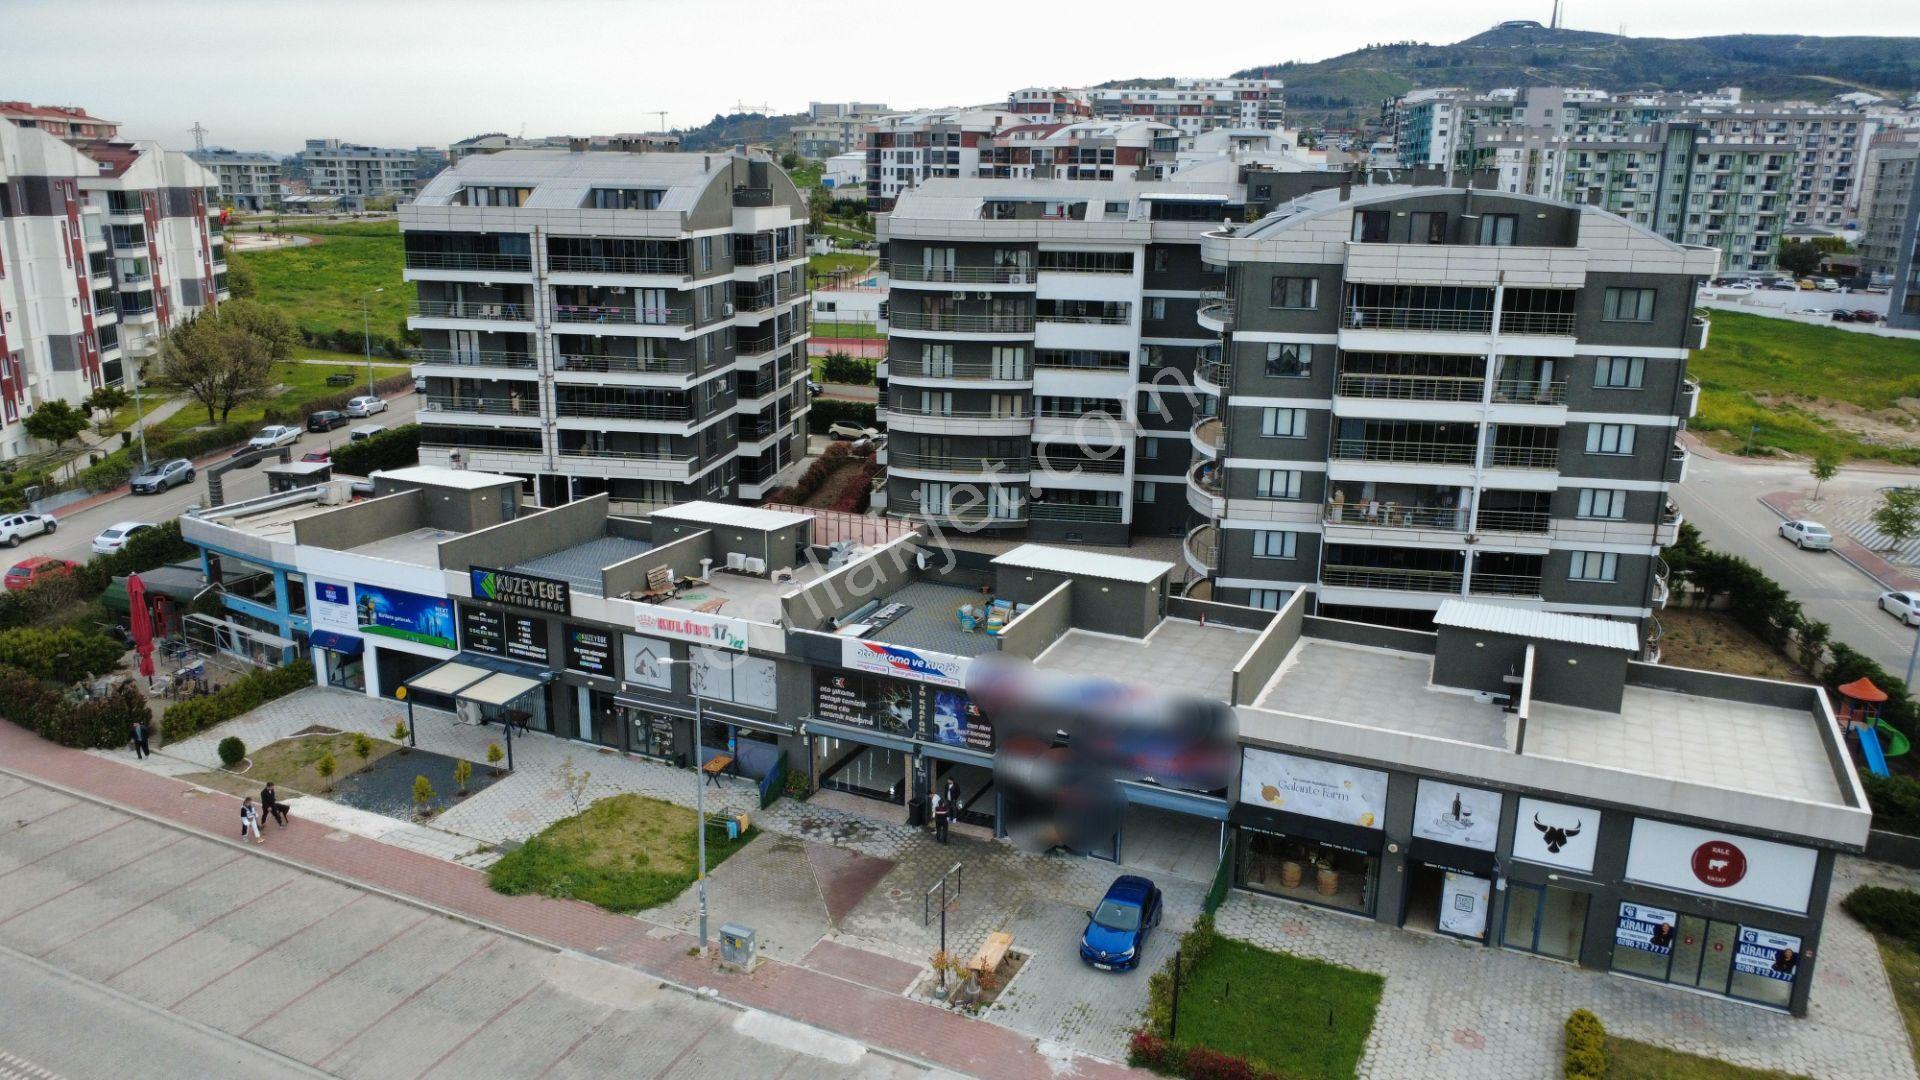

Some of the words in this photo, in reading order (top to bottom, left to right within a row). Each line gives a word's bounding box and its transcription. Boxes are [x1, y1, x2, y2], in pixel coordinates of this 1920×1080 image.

[496, 574, 565, 601] KUZEYEGE
[712, 622, 728, 640] 17
[912, 658, 924, 667] ve
[1620, 917, 1655, 935] KİRALIK
[1616, 937, 1635, 946] 0286
[1636, 941, 1649, 950] 212
[1650, 944, 1660, 952] 77
[1660, 946, 1670, 954] 77
[1740, 943, 1777, 961] KİRALIK
[1736, 963, 1755, 973] 0286
[1756, 967, 1771, 977] 212
[1771, 970, 1781, 979] 77
[1783, 972, 1793, 981] 77
